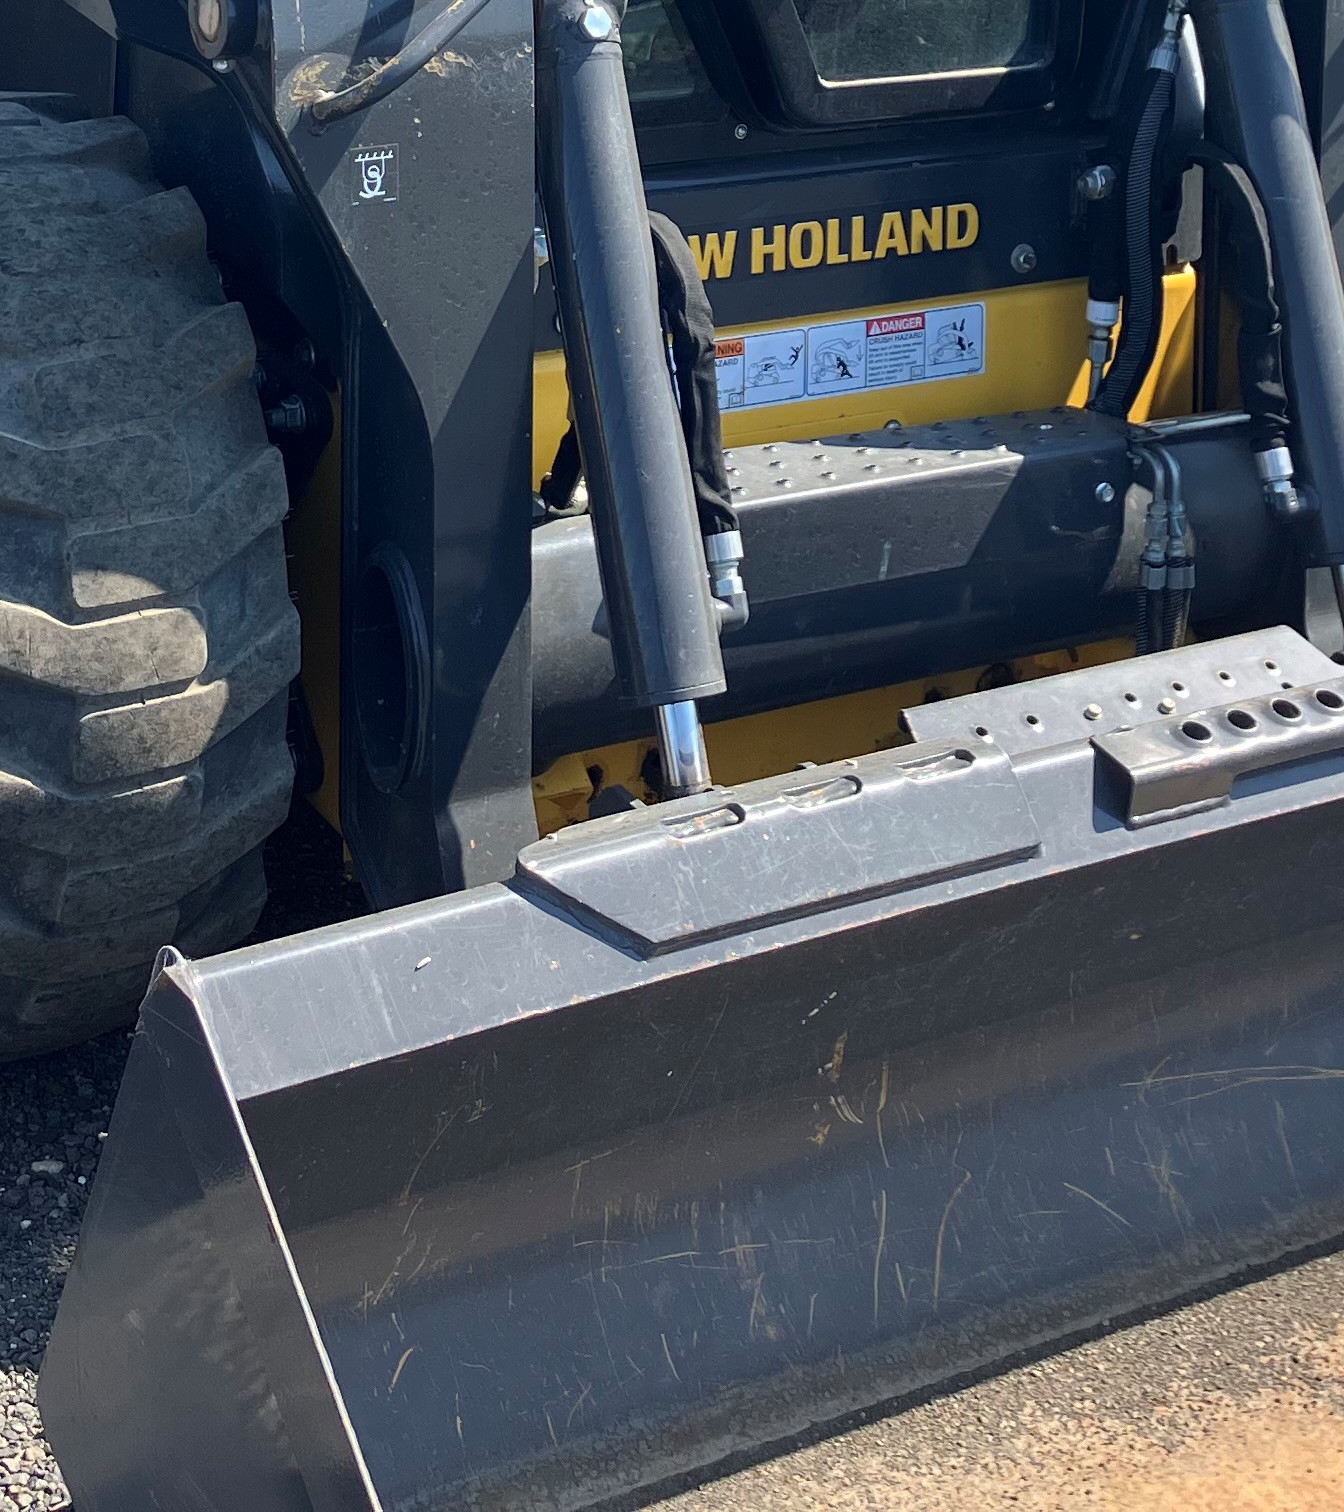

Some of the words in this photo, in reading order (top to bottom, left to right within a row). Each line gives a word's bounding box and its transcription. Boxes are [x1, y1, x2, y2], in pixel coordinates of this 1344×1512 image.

[750, 202, 980, 275] HOLLAND
[881, 316, 923, 332] DANGER
[868, 336, 894, 346] CRUSH
[894, 331, 924, 342] HAZARD
